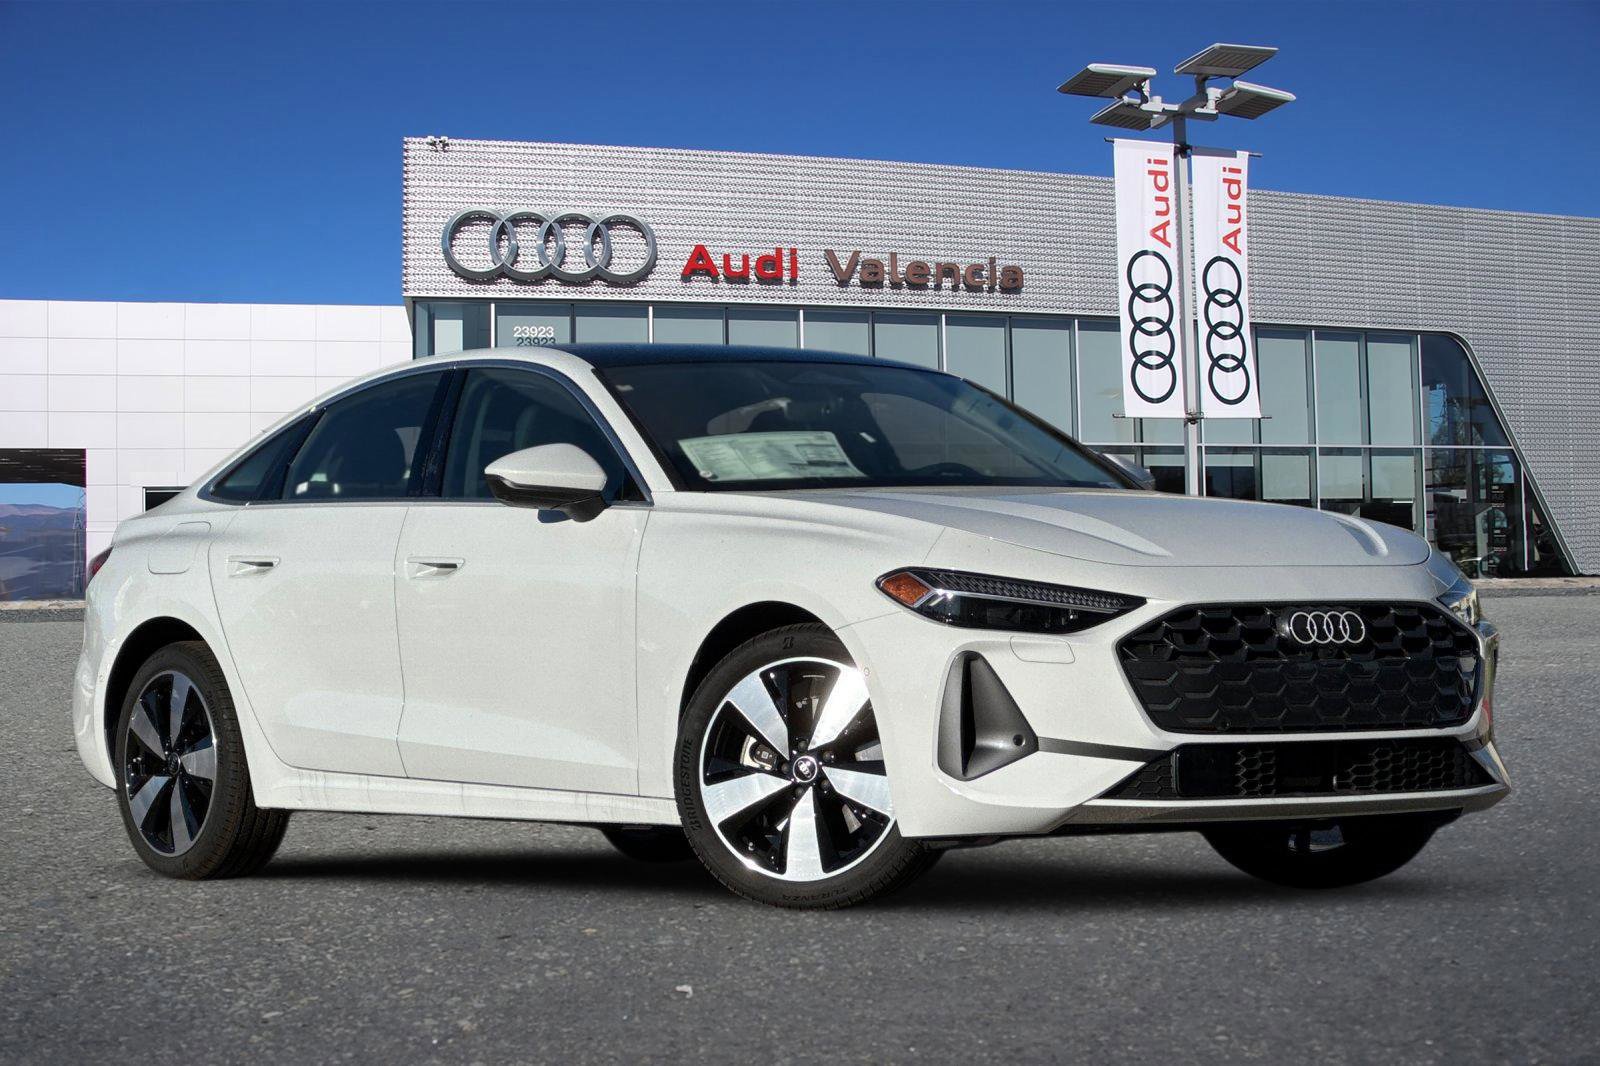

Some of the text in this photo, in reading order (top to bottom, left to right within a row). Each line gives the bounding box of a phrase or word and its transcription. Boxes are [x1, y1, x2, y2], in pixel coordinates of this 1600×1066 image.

[1147, 158, 1171, 249] Audi
[1222, 166, 1242, 255] Audi
[681, 244, 1024, 295] Audi Valencia
[513, 326, 554, 337] 23923
[680, 737, 703, 832] BRIDGESTONE
